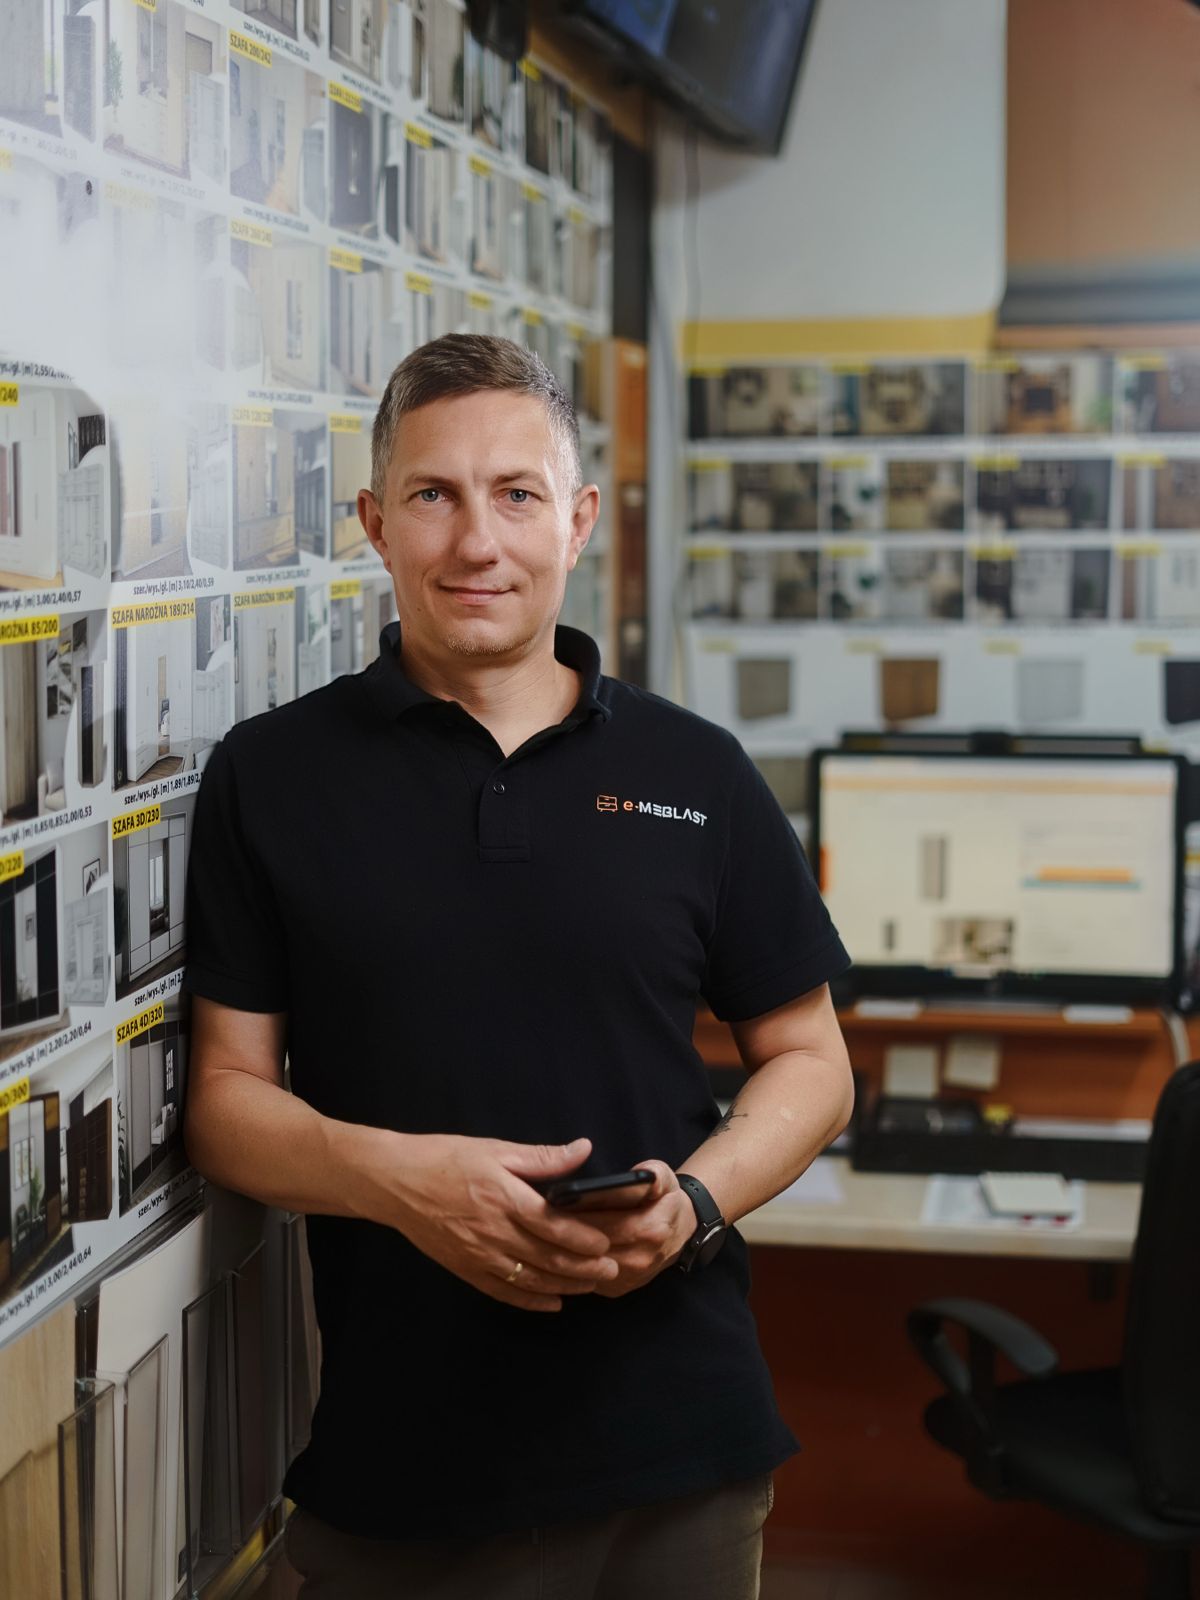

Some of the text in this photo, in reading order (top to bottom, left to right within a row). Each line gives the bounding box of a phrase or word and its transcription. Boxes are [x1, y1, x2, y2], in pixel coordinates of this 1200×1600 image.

[230, 33, 248, 51] SZAFA
[112, 602, 194, 625] SZAFA NAROŻNA 189/214
[31, 618, 58, 636] 85/200
[160, 780, 170, 796] [m]
[113, 808, 160, 835] SZAFA 3D/230
[117, 1006, 163, 1042] SZAFA 4D/320
[49, 1021, 91, 1053] 2,20/2,20/0,64
